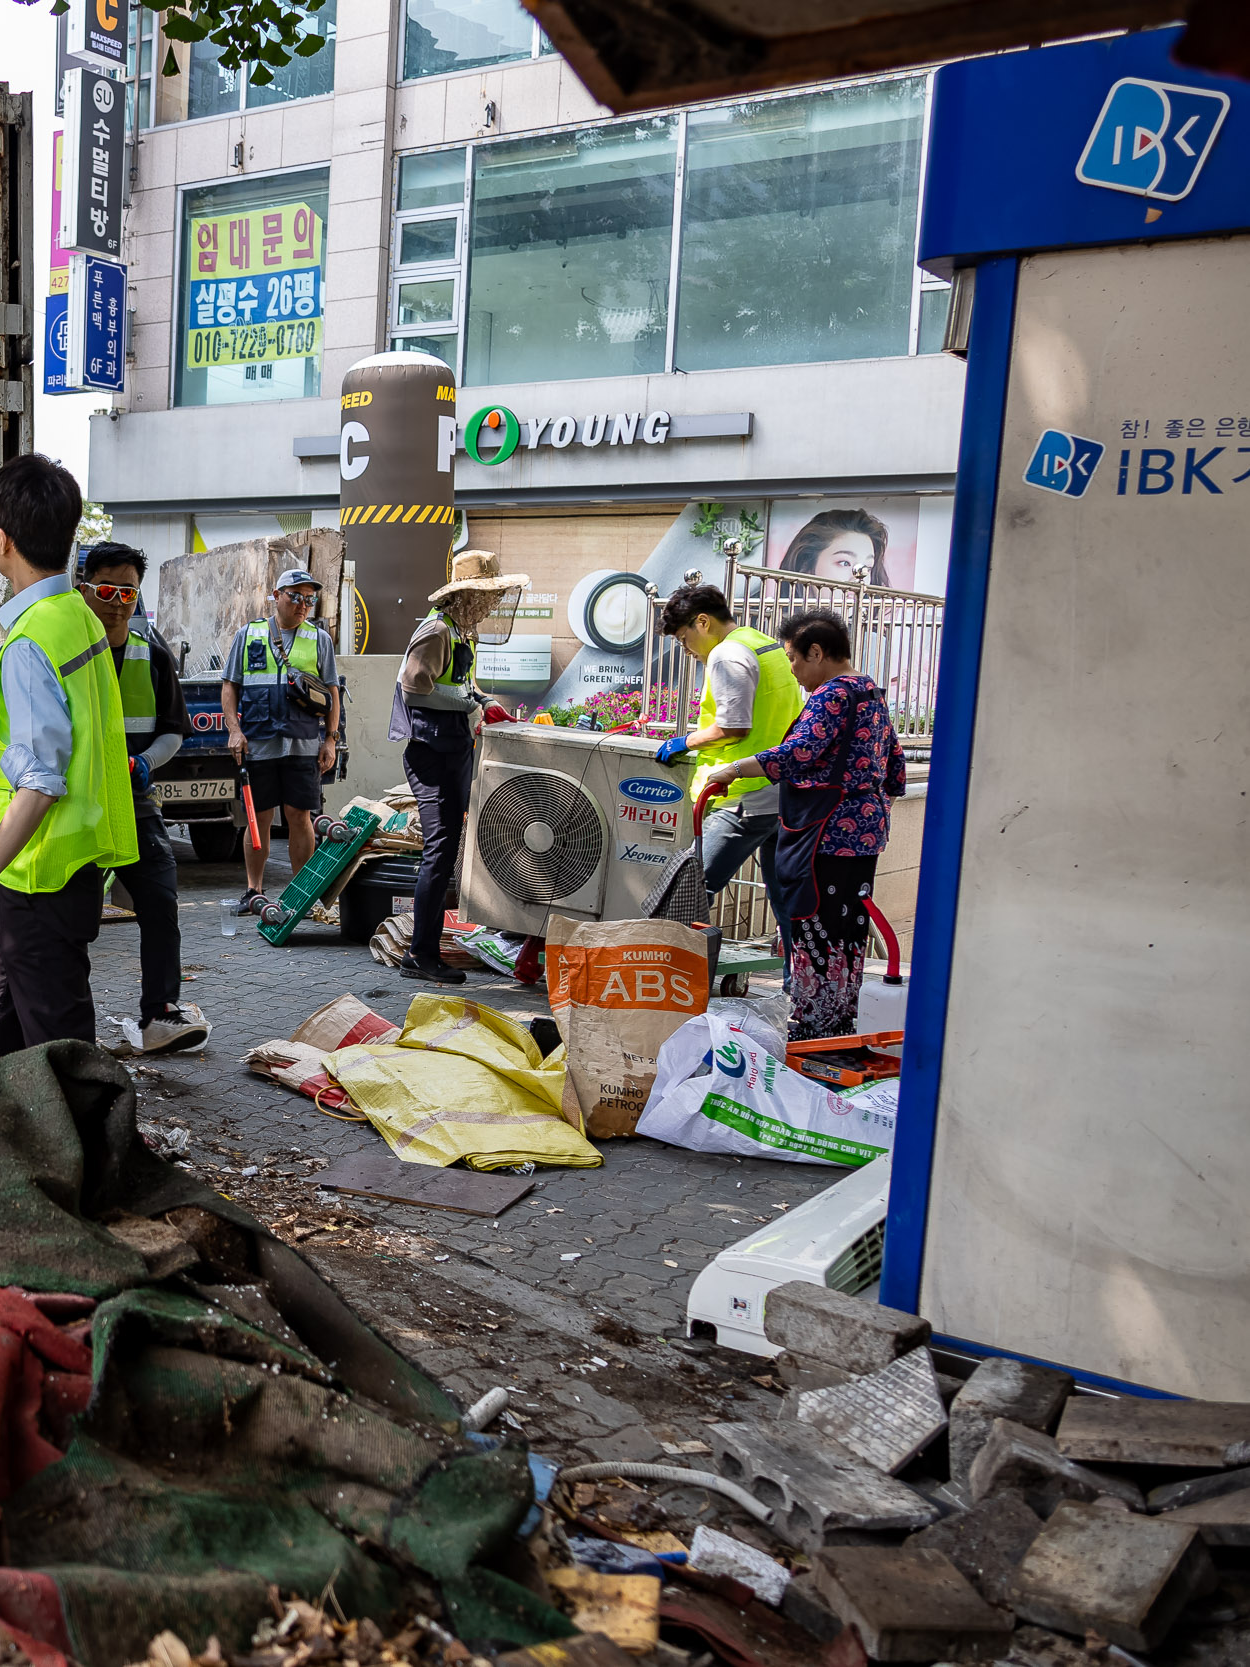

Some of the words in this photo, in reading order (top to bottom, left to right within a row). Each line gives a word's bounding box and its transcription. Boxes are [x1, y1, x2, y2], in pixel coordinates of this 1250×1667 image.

[90, 31, 123, 49] MAXSPEED
[95, 87, 112, 106] SU
[90, 118, 111, 237] 수멀티방
[107, 238, 118, 250] 6F
[195, 279, 259, 325] 실평수
[266, 271, 315, 317] 26평
[90, 357, 103, 375] 6F
[528, 410, 671, 450] YOUNG
[1164, 417, 1206, 439] 좋은
[584, 665, 597, 673] WE
[598, 665, 625, 674] BRING
[583, 675, 612, 683] GREEN
[190, 782, 228, 797] 8776
[628, 782, 675, 798] Carrier
[618, 804, 678, 828] 캐리어
[622, 951, 672, 962] KUMHO
[599, 971, 694, 1007] ABS
[623, 1052, 645, 1063] NET
[600, 1083, 644, 1099] KUMHO
